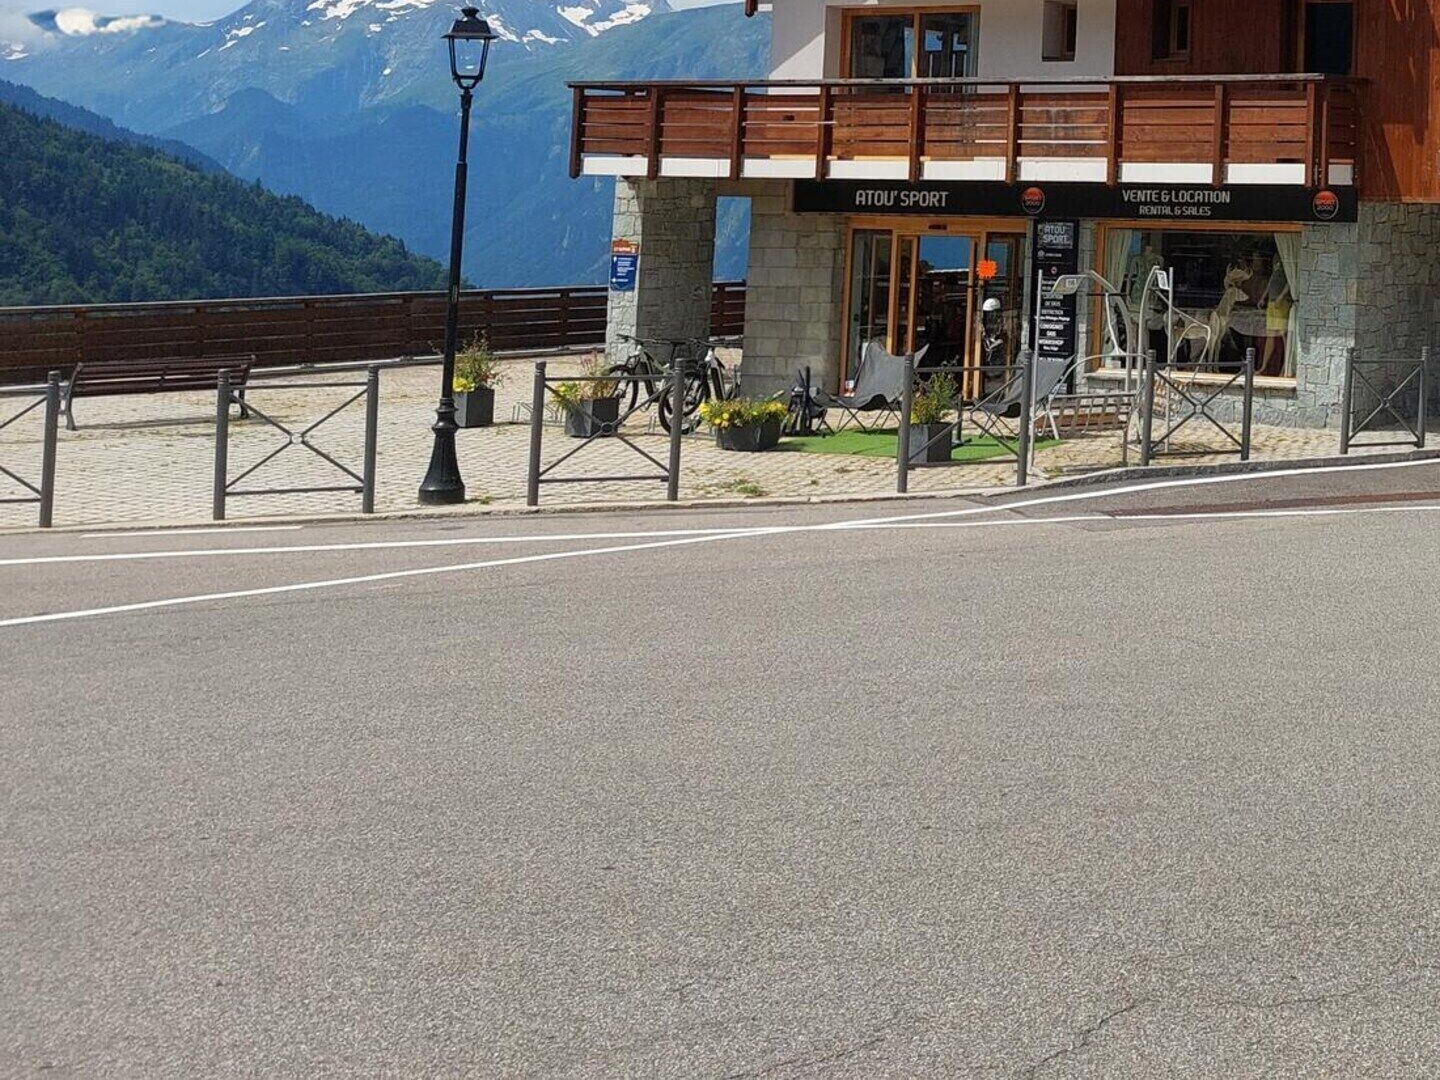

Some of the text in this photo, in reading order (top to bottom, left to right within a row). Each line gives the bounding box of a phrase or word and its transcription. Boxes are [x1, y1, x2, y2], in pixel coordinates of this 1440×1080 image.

[855, 189, 949, 207] ATOU' SPORT
[1122, 189, 1230, 203] VENTE & LOCATION
[1140, 205, 1211, 216] RENTAL & SALES
[1042, 234, 1068, 244] SPORT
